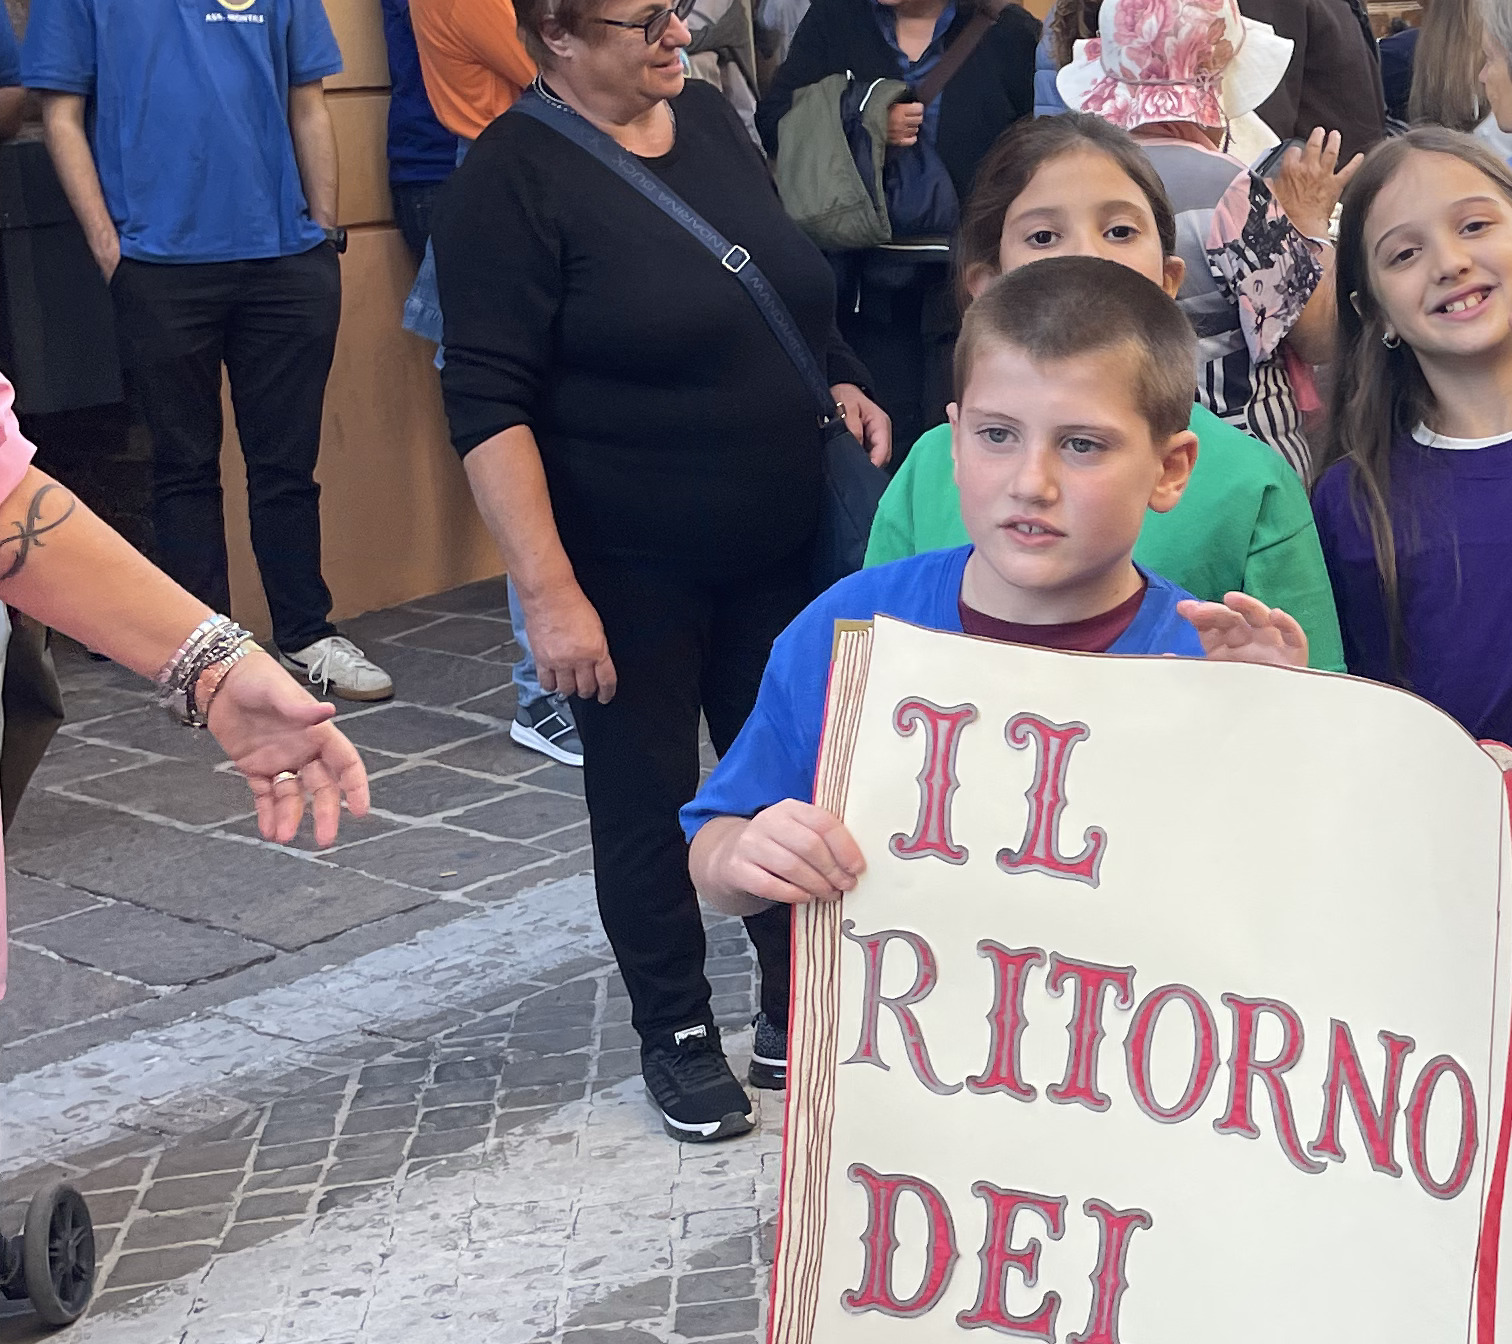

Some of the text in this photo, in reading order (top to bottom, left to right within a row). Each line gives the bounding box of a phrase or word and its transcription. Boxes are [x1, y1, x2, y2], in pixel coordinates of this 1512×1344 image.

[658, 191, 729, 256] ANDARINA
[889, 696, 1107, 888] IL
[839, 919, 1479, 1200] RITORNO
